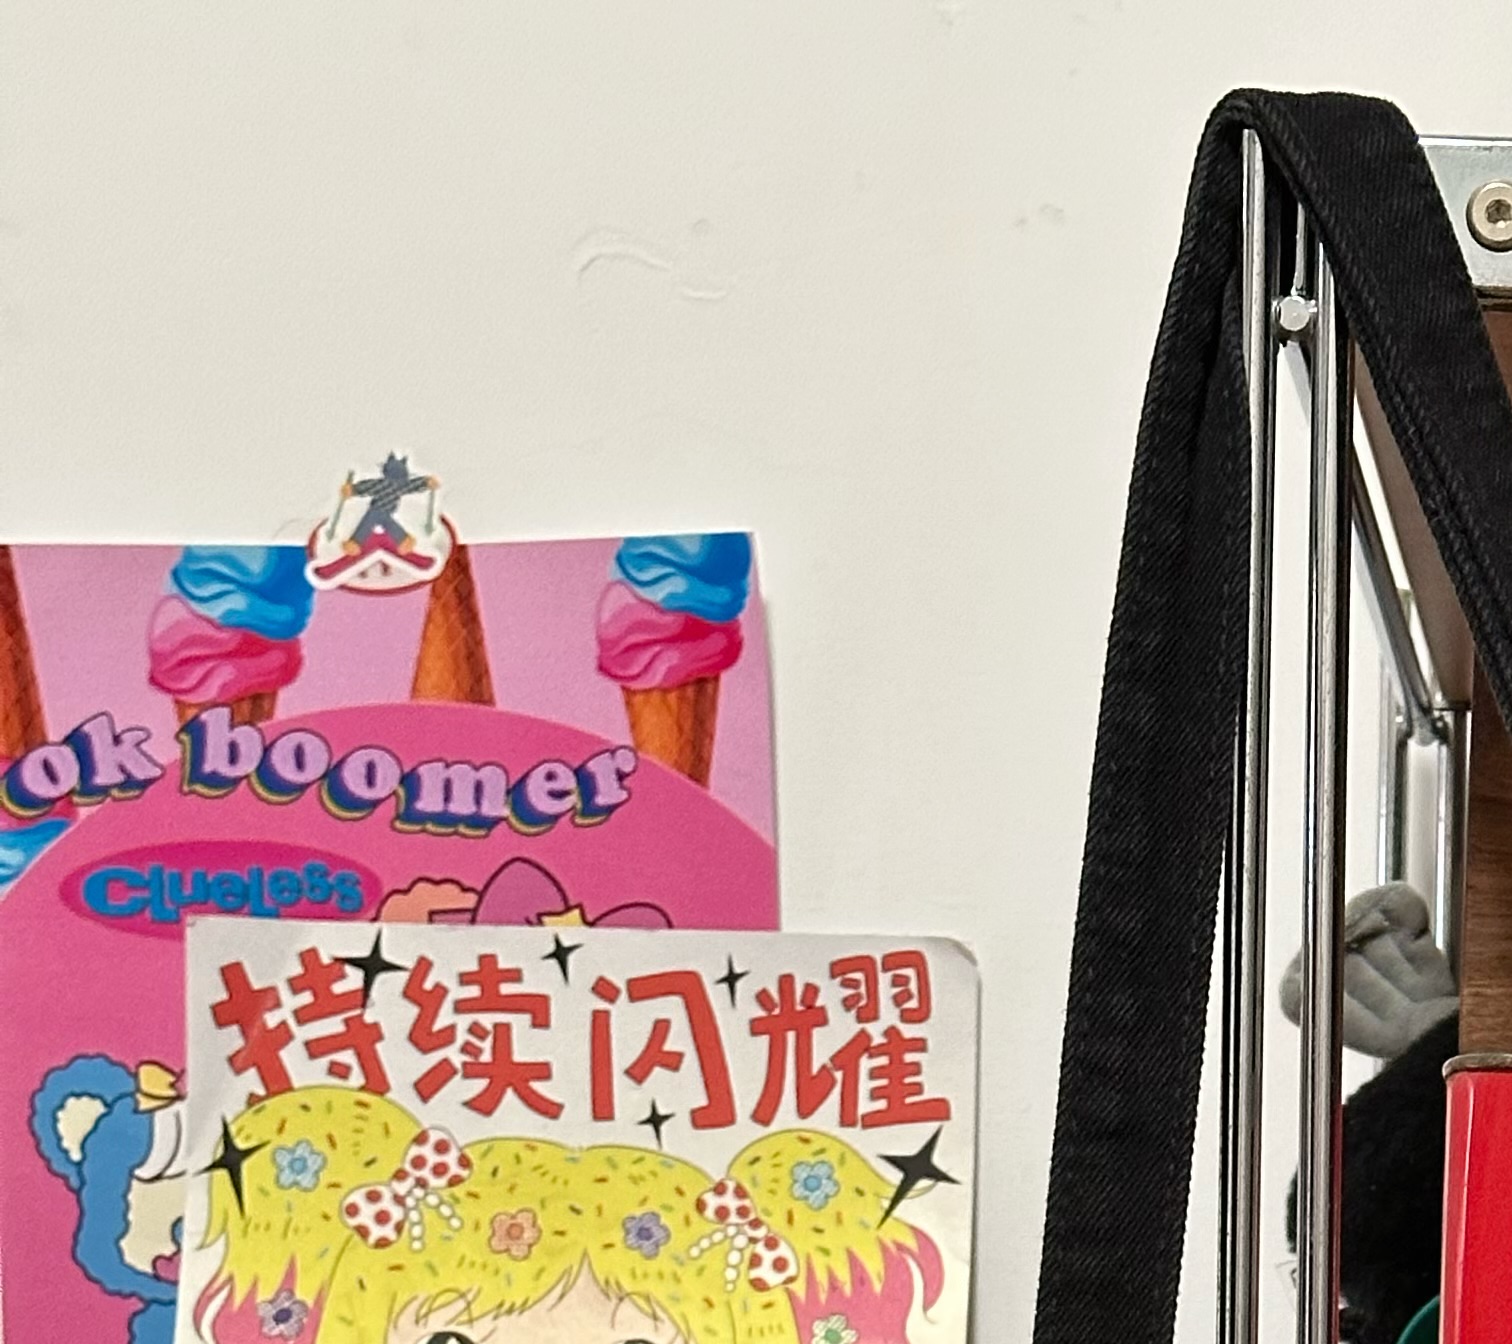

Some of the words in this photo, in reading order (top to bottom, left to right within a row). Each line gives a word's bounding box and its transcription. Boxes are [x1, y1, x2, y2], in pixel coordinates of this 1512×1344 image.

[2, 712, 165, 818] ok
[176, 706, 638, 838] boomer
[210, 946, 952, 1130] 持续闪耀
